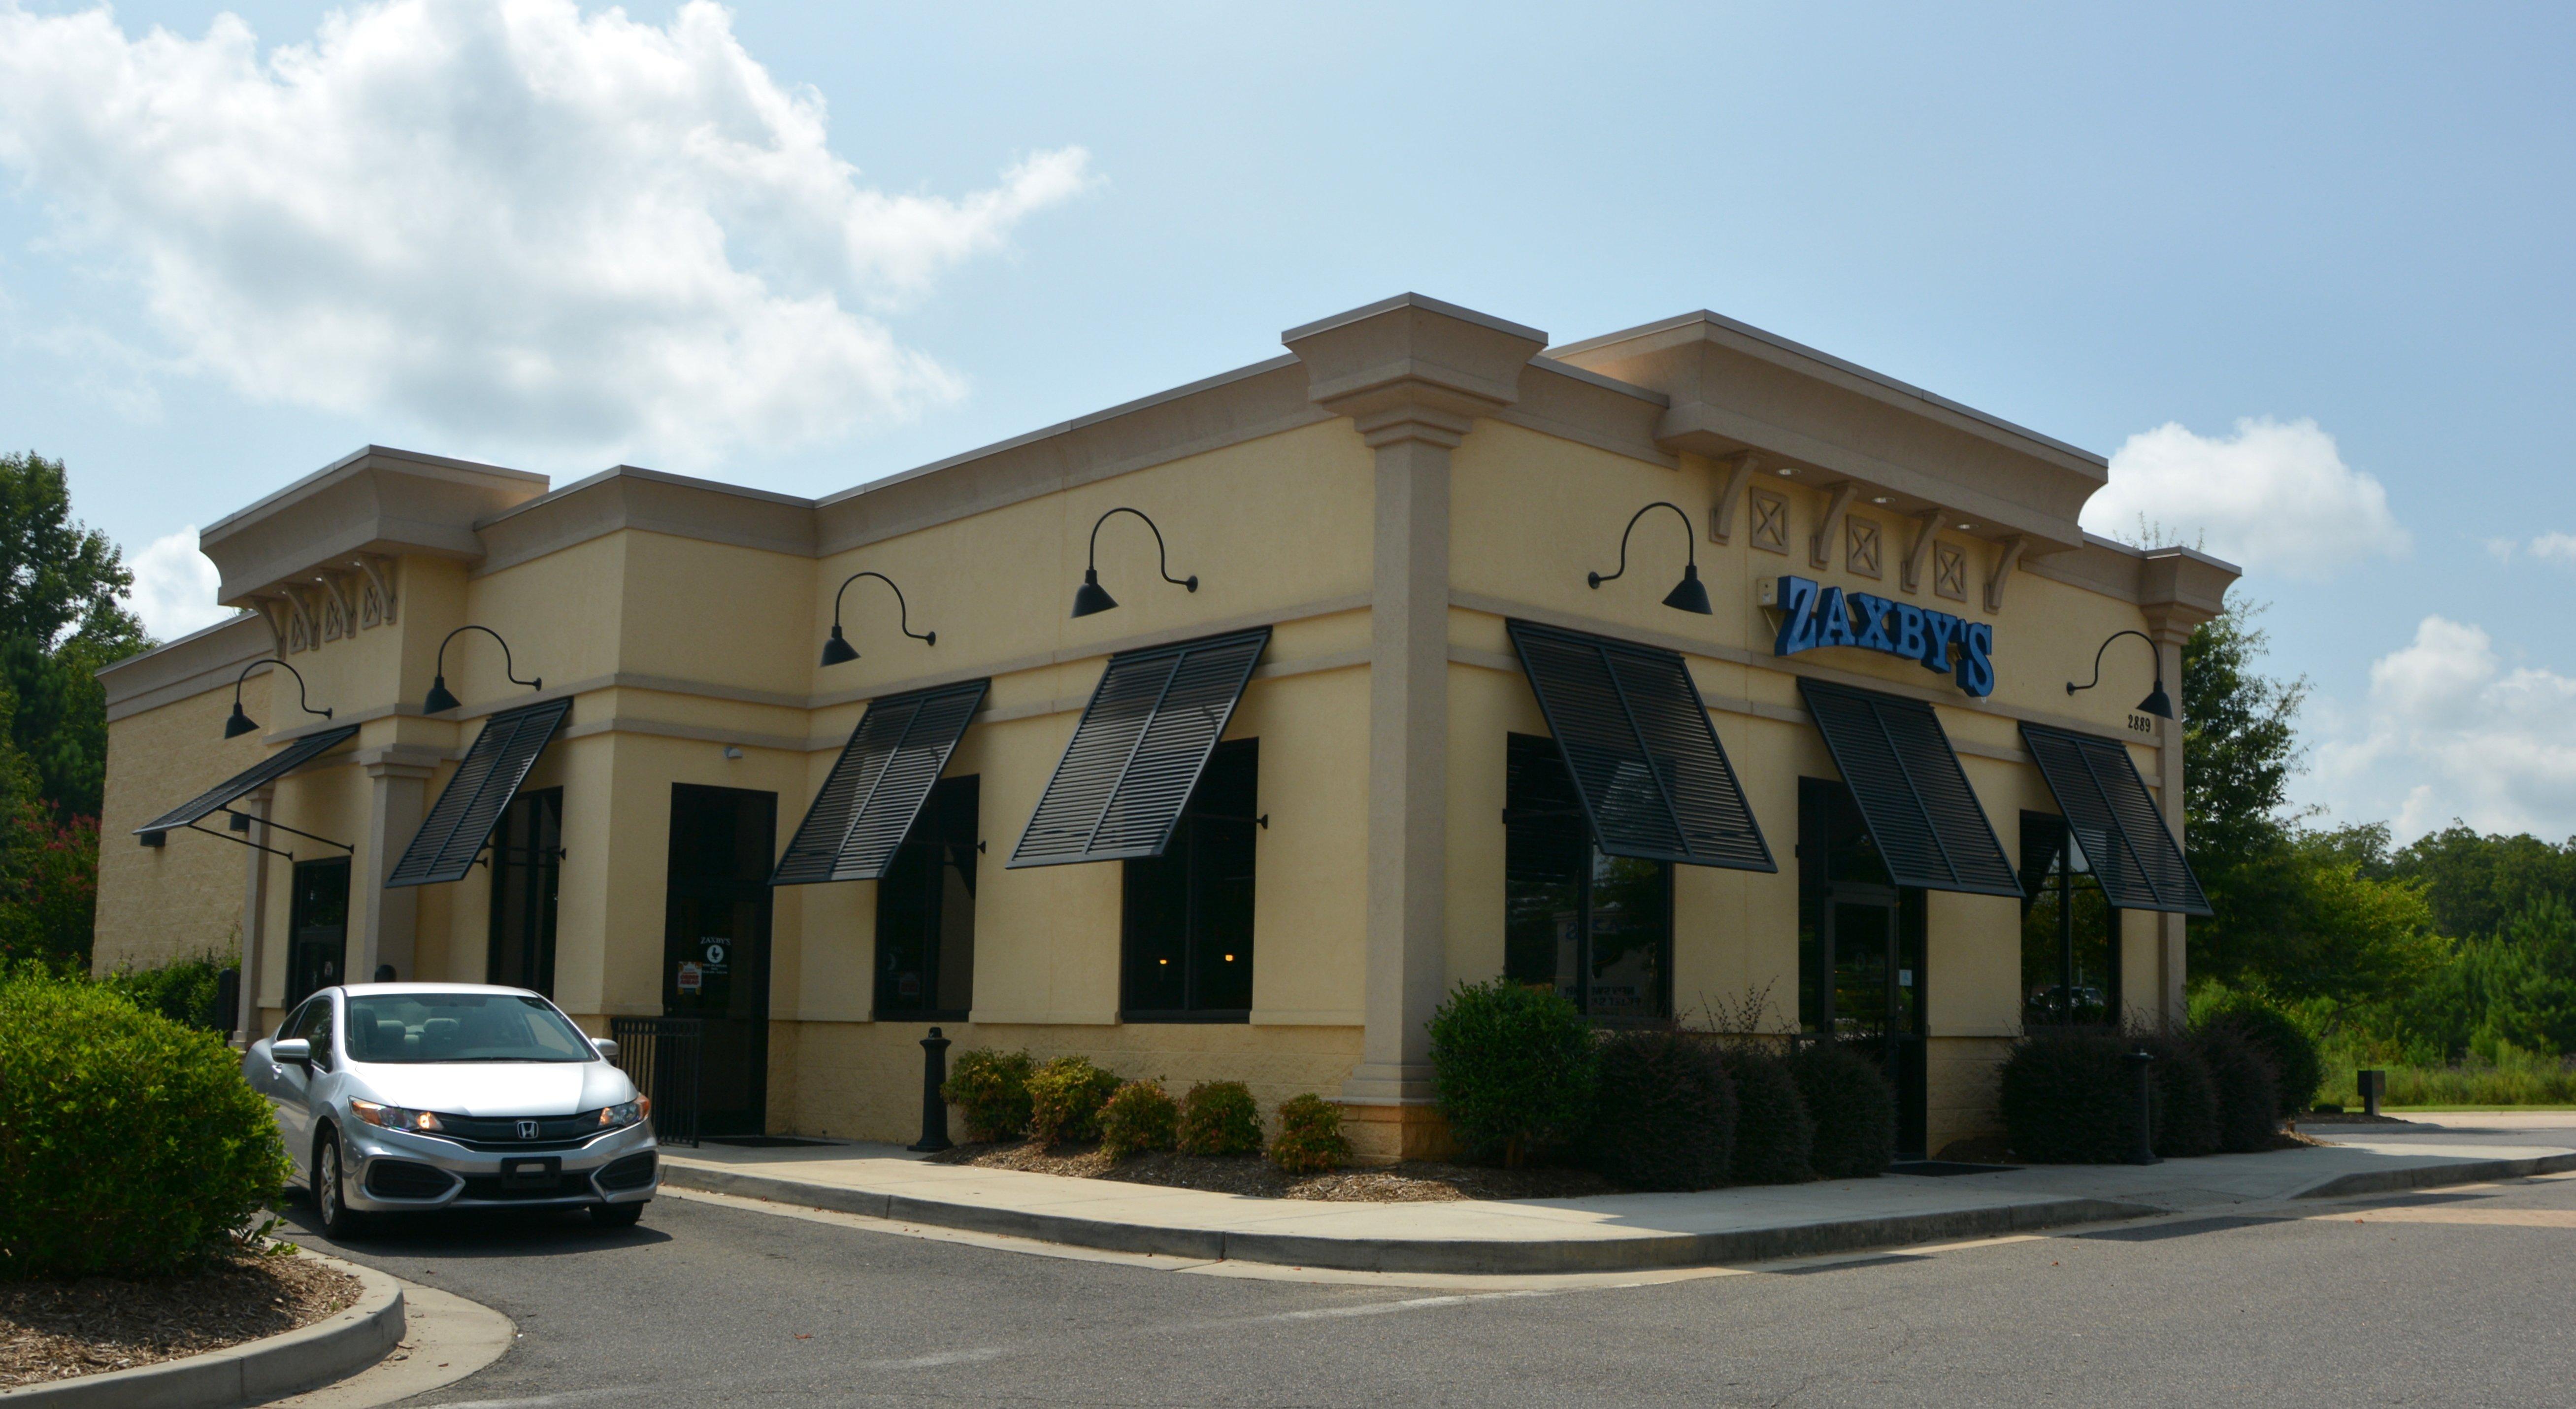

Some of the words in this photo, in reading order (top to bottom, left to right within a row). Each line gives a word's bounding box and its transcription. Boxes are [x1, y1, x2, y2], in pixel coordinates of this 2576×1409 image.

[1775, 575, 1994, 697] ZAXBY'S
[2128, 714, 2150, 733] 2889
[700, 937, 731, 946] ZAXBY'S
